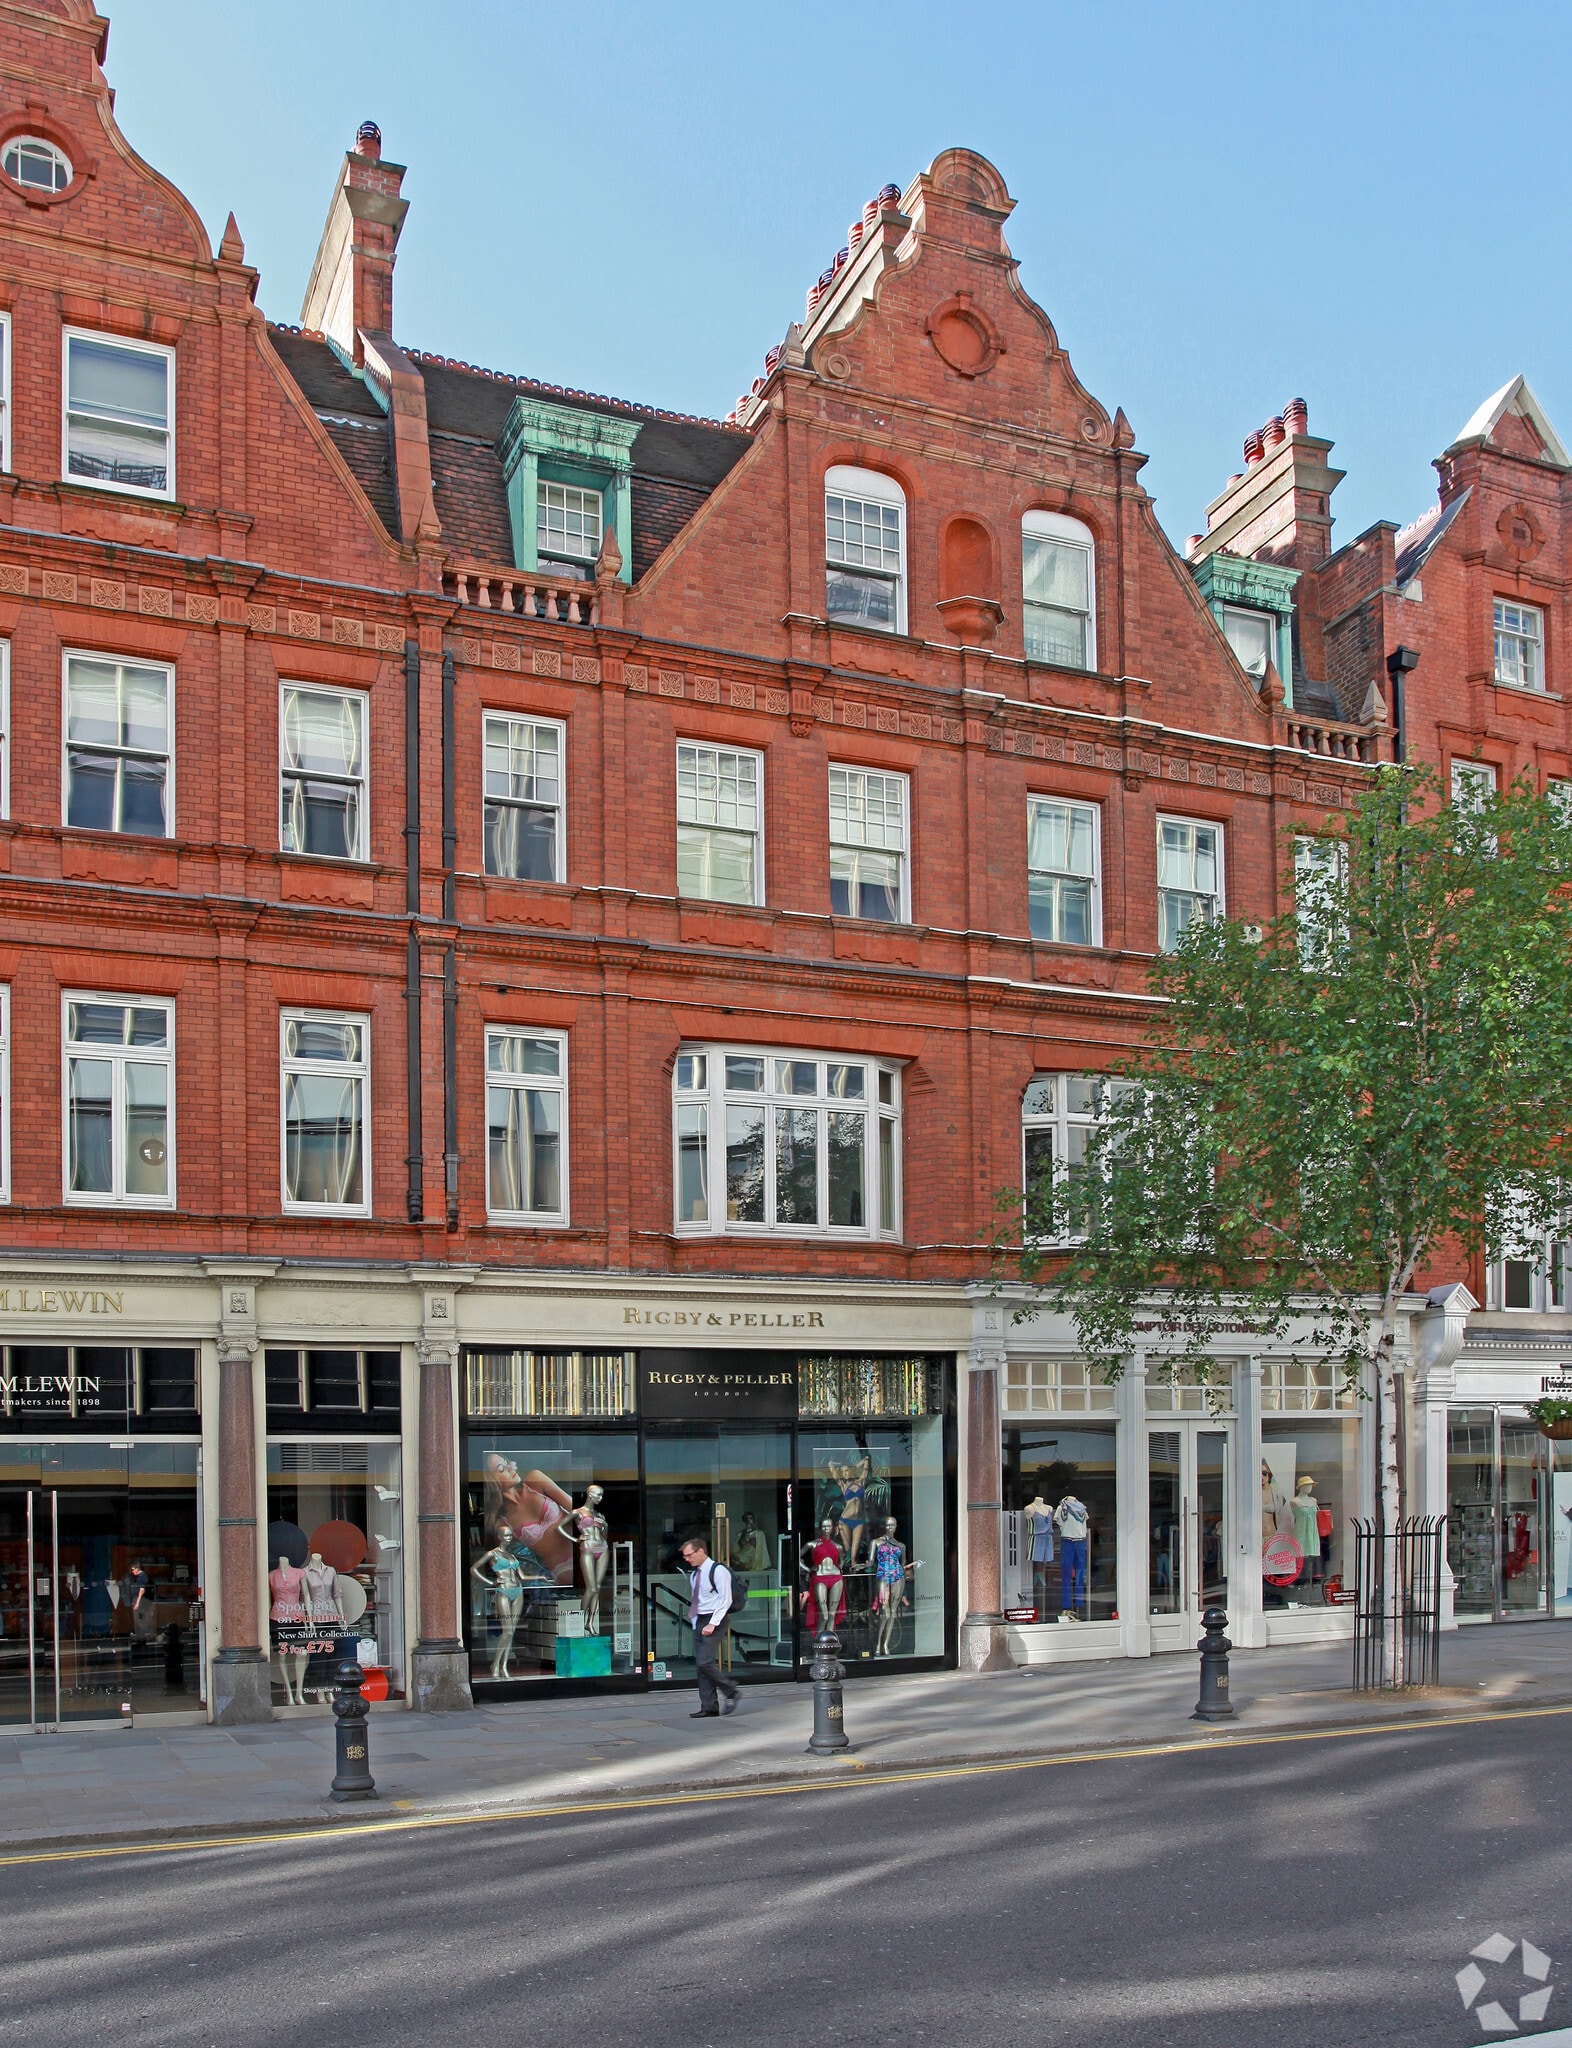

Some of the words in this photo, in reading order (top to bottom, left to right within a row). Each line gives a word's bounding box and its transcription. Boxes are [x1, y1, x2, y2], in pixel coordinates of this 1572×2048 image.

[623, 1307, 702, 1325] RIGBY
[706, 1312, 722, 1325] &
[729, 1311, 825, 1328] PELLER
[648, 1371, 705, 1385] RIGBY
[708, 1374, 720, 1384] &
[724, 1372, 794, 1385] PELLER
[46, 1398, 72, 1406] since
[77, 1398, 100, 1406] 1898
[278, 1600, 332, 1614] Spotlight
[277, 1616, 292, 1624] on
[293, 1612, 347, 1624] Summer
[278, 1631, 296, 1640] New
[298, 1630, 318, 1639] Shirt
[319, 1629, 360, 1638] Collection
[278, 1641, 289, 1655] 3
[289, 1644, 306, 1654] for
[306, 1640, 335, 1654] £75
[303, 1687, 317, 1695] Shop
